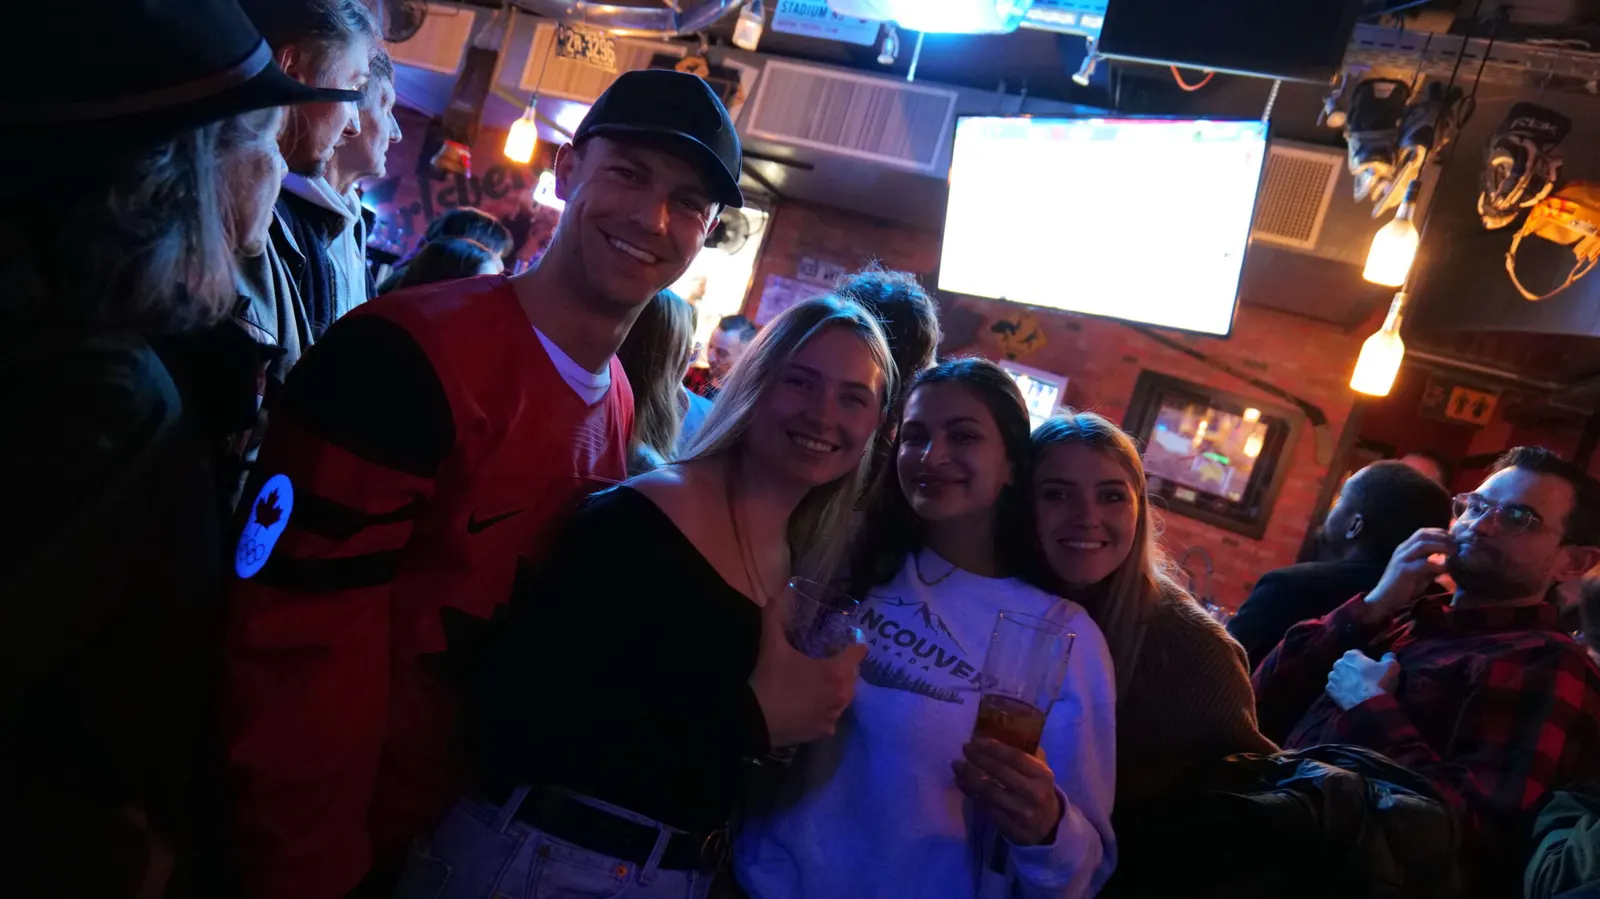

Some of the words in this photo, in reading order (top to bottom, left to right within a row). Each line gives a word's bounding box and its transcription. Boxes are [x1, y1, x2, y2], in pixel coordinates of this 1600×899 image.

[780, 2, 829, 20] STADIUM
[860, 608, 999, 689] NCOUVER
[869, 637, 930, 672] ANADA
